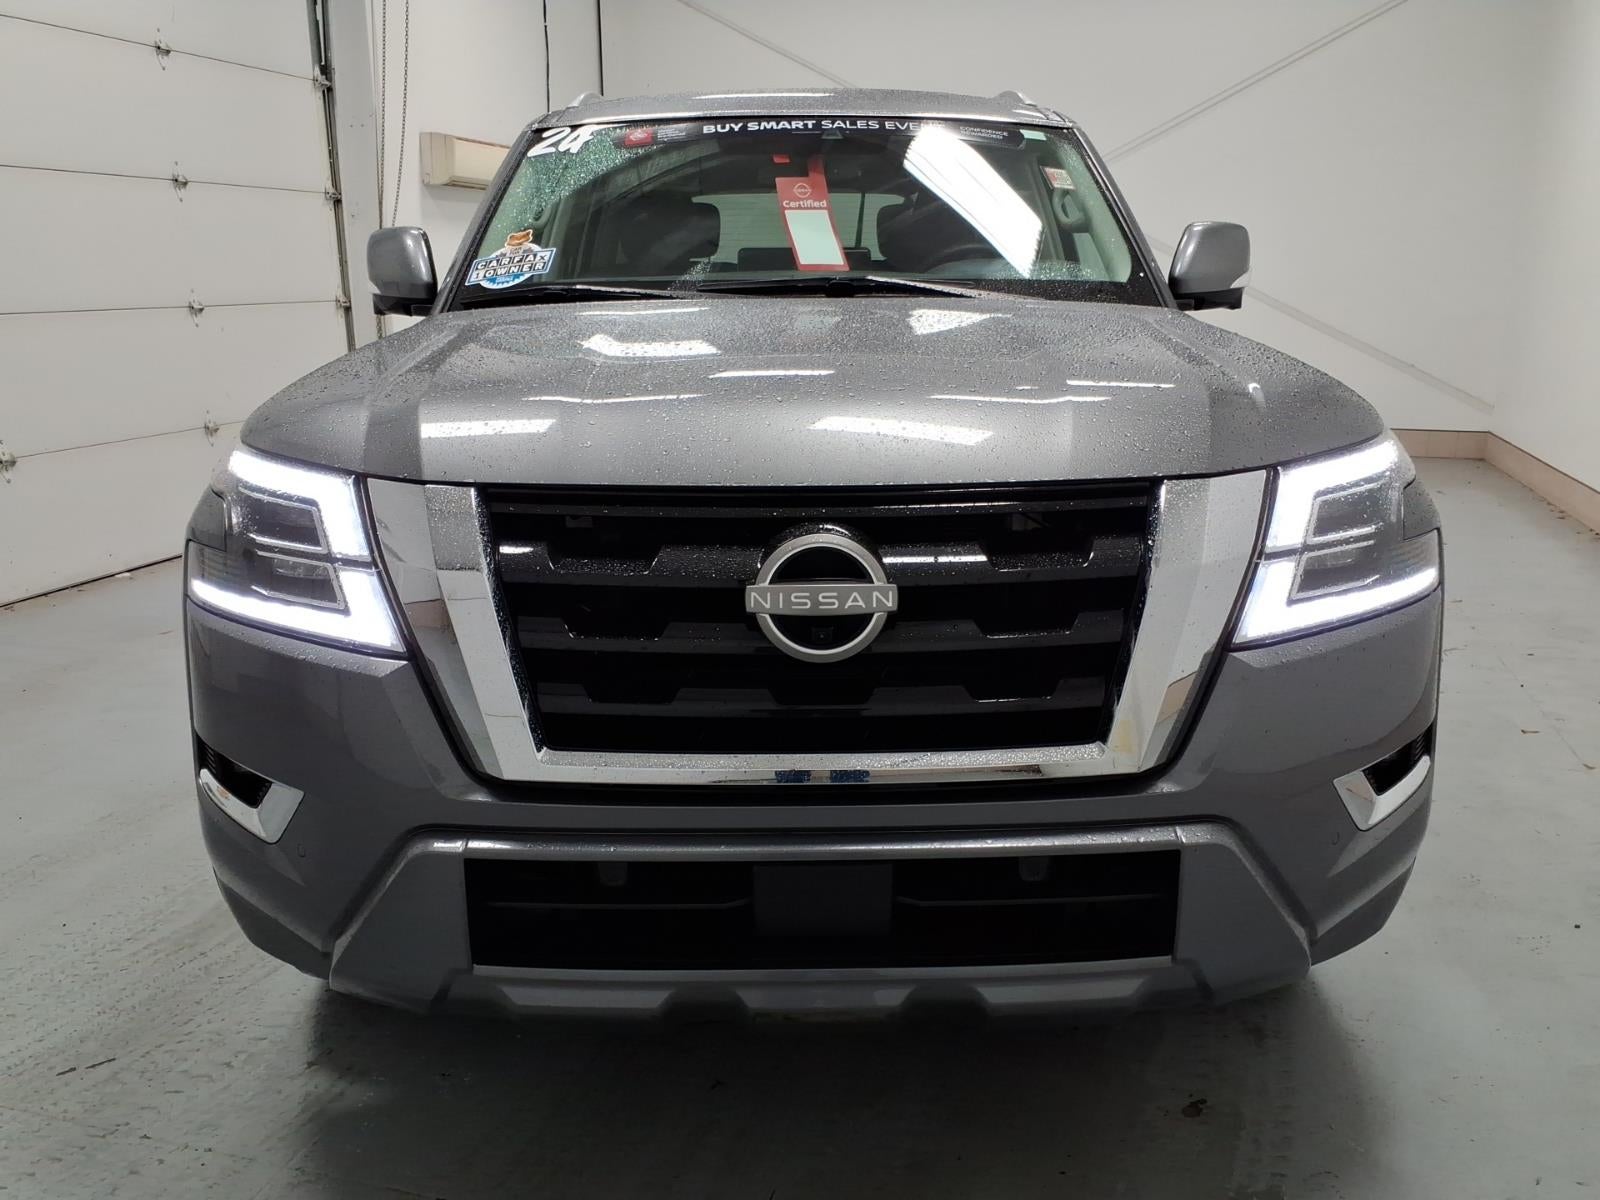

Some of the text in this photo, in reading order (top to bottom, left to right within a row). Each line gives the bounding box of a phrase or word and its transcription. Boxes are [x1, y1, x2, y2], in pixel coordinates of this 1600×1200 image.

[703, 120, 940, 134] BUY SMART SALES EVE
[527, 125, 618, 157] 24
[783, 199, 827, 208] Certified
[477, 253, 548, 269] CARFAX
[485, 262, 544, 277] OWNER
[750, 590, 893, 609] NISSAN
